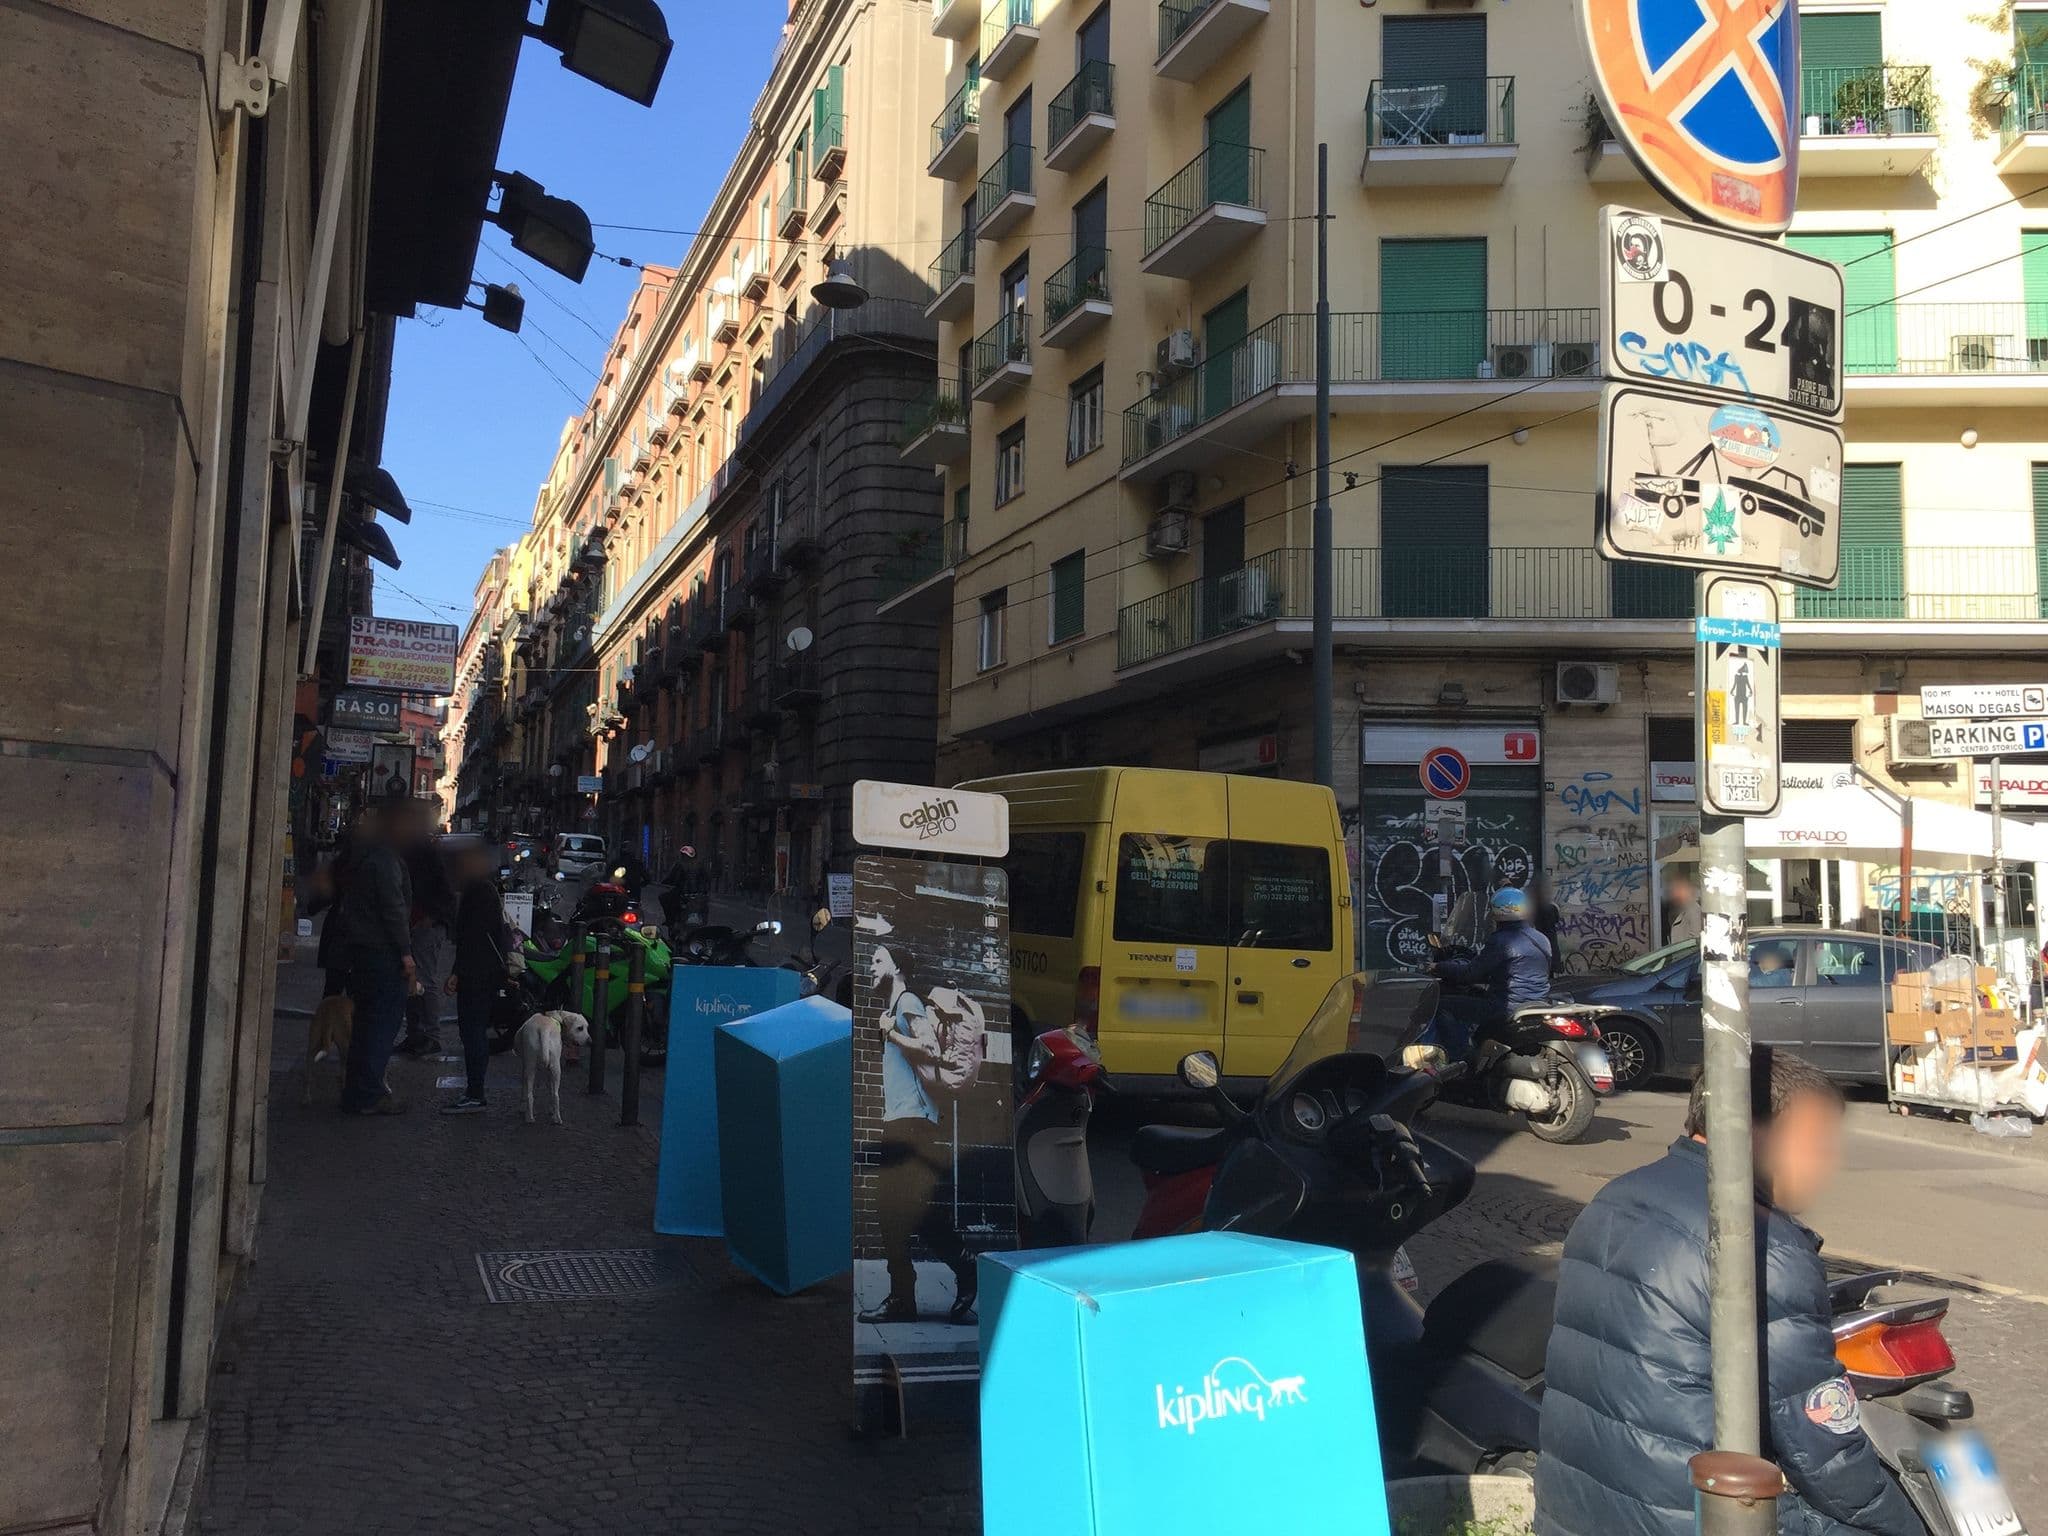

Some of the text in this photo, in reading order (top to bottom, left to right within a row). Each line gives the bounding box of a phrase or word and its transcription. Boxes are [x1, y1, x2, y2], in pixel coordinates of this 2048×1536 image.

[1743, 288, 1797, 354] 2
[1789, 388, 1809, 406] STATE
[1810, 393, 1818, 407] OF
[352, 618, 455, 642] STEFANELLI
[352, 634, 454, 654] TRASLOCHI
[1924, 690, 1938, 698] 100
[335, 699, 398, 716] RASOI
[1925, 703, 2021, 715] MAISON DEGAS
[1932, 726, 2016, 745] PARKING
[1960, 745, 1989, 753] CENTRO
[1991, 744, 2023, 752] STORICO
[1656, 775, 1696, 785] TORAL
[1979, 780, 2048, 791] TRALDO
[900, 797, 960, 830] cabin
[916, 816, 957, 841] zero
[1778, 830, 1848, 842] TORALDO
[1128, 953, 1174, 964] TRANSIT
[695, 997, 737, 1017] kipling
[1156, 1375, 1265, 1435] kipling
